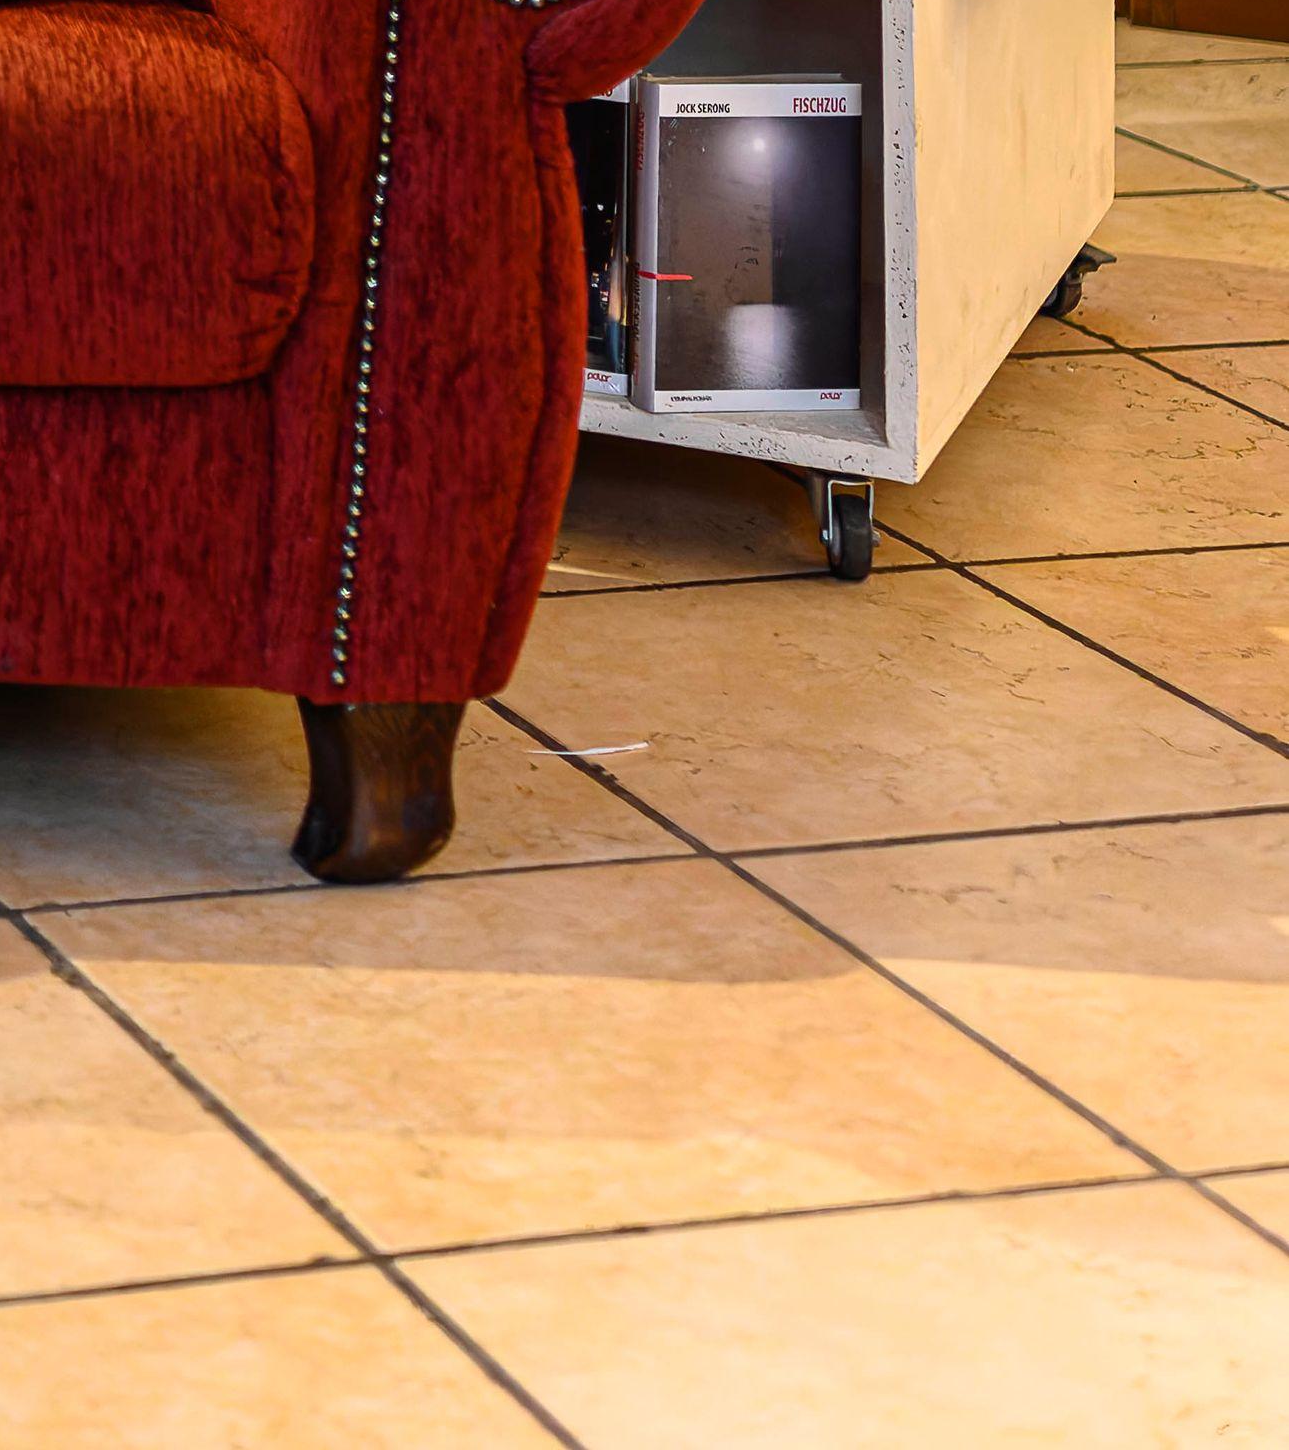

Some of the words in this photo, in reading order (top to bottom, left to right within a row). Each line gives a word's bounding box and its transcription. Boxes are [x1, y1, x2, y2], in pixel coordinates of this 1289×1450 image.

[677, 102, 696, 113] JOCK
[698, 102, 730, 114] SERONG
[793, 96, 847, 114] FISCHZUG
